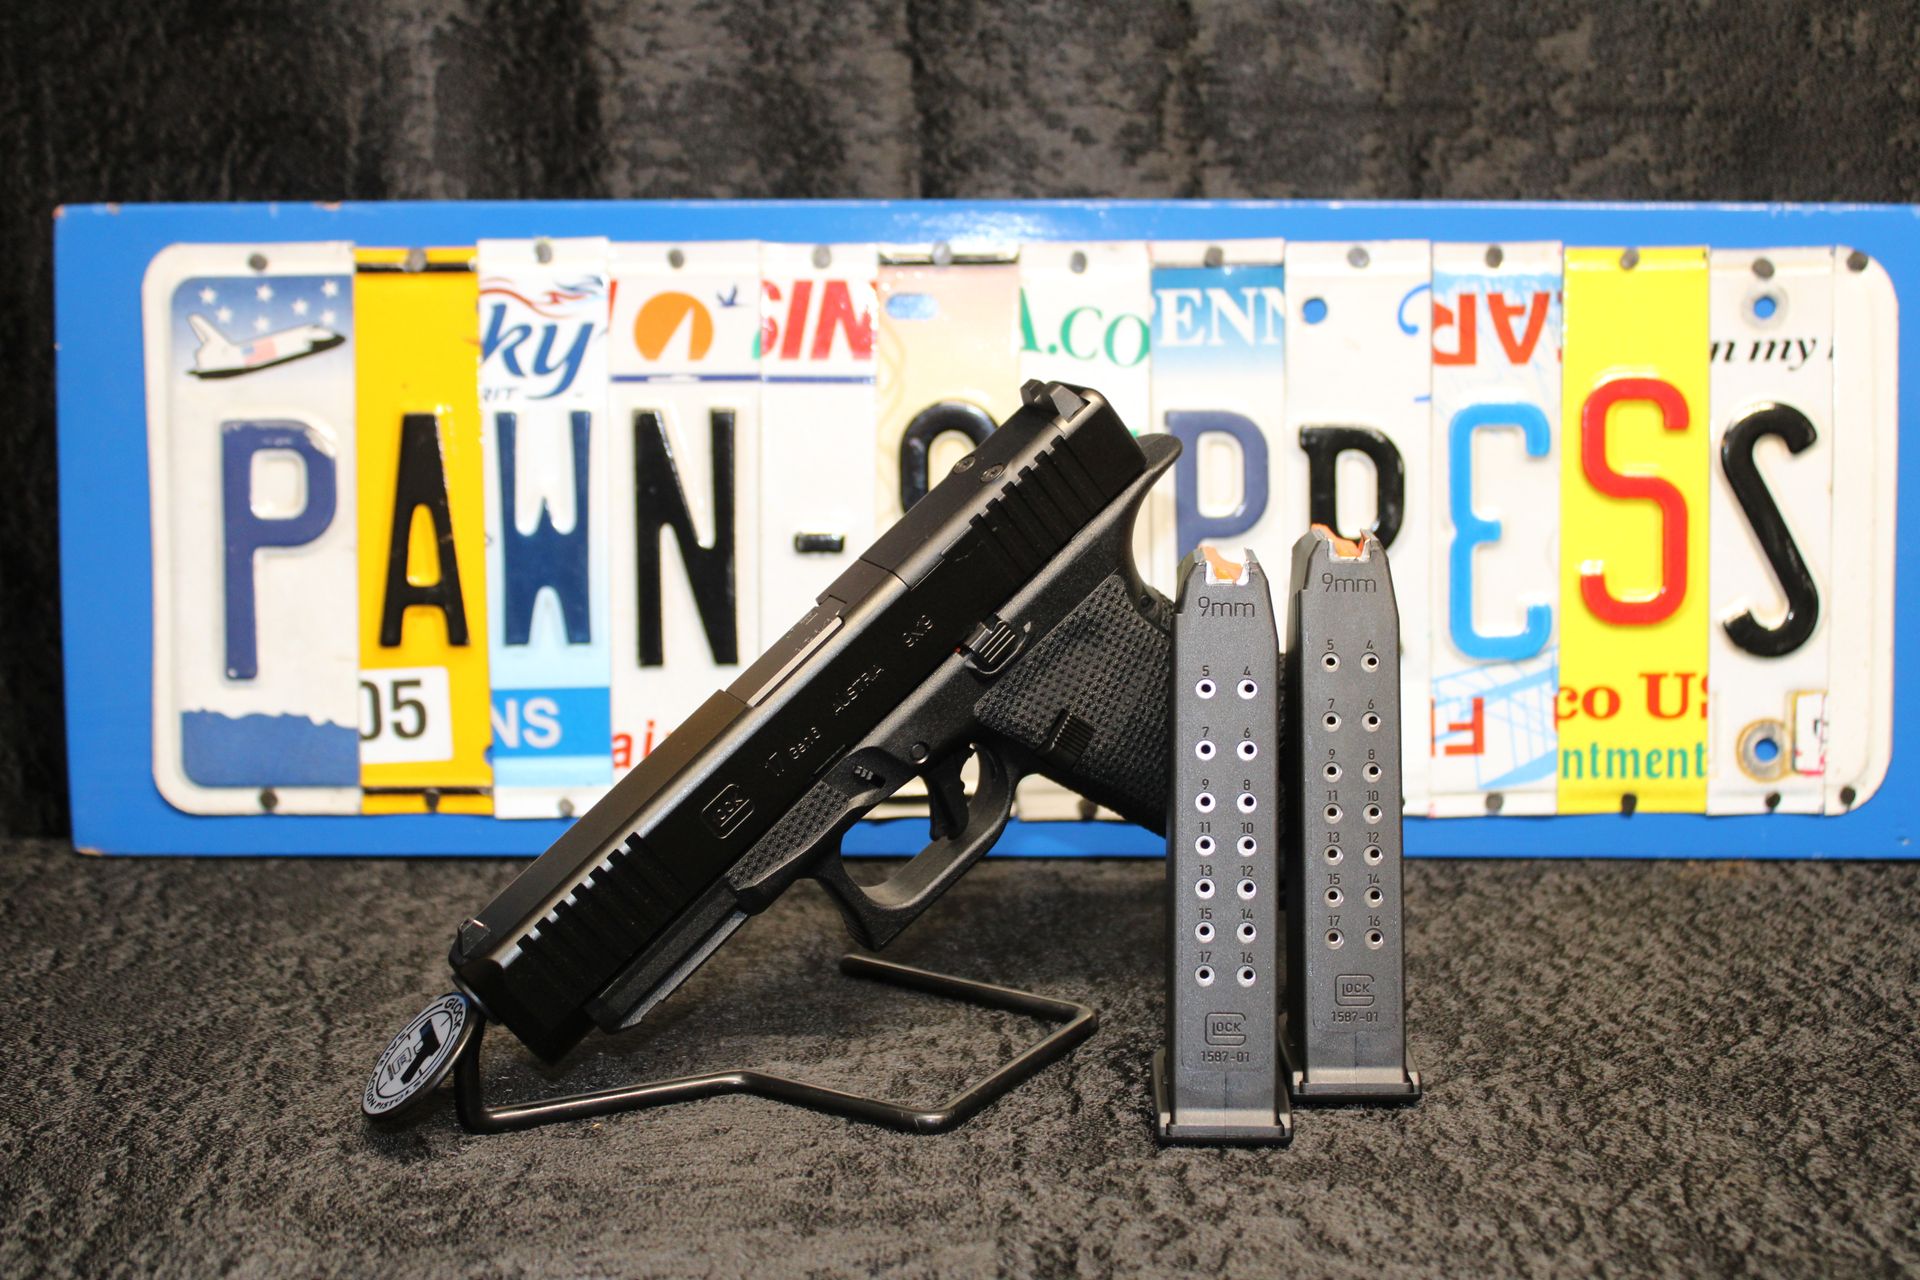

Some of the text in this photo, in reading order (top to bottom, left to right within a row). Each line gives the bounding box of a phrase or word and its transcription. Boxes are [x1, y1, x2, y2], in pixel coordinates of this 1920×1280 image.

[481, 302, 595, 400] ky
[1747, 337, 1818, 372] my
[1320, 572, 1377, 593] 9mm
[1197, 596, 1256, 618] 9mm
[1326, 639, 1374, 651] 5 4
[1201, 665, 1252, 677] 5 4
[1638, 672, 1708, 721] U
[1327, 698, 1375, 710] 7 6
[1201, 726, 1251, 738] 7 6
[1328, 748, 1375, 760] 9 8
[1562, 742, 1707, 789] ntment
[1201, 778, 1251, 790] 9 8
[1326, 790, 1379, 802] 11 10
[1198, 821, 1254, 834] 11 10
[1327, 831, 1379, 843] 13 12
[1199, 865, 1254, 877] 13 12
[1327, 873, 1380, 885] 15 14
[1198, 907, 1254, 920] 15 14
[1327, 915, 1381, 927] 17 16
[1198, 951, 1254, 964] 17 16
[1331, 1011, 1379, 1023] 1587-01
[1200, 1051, 1251, 1063] 1587-01
[365, 1071, 378, 1108] ACTION
